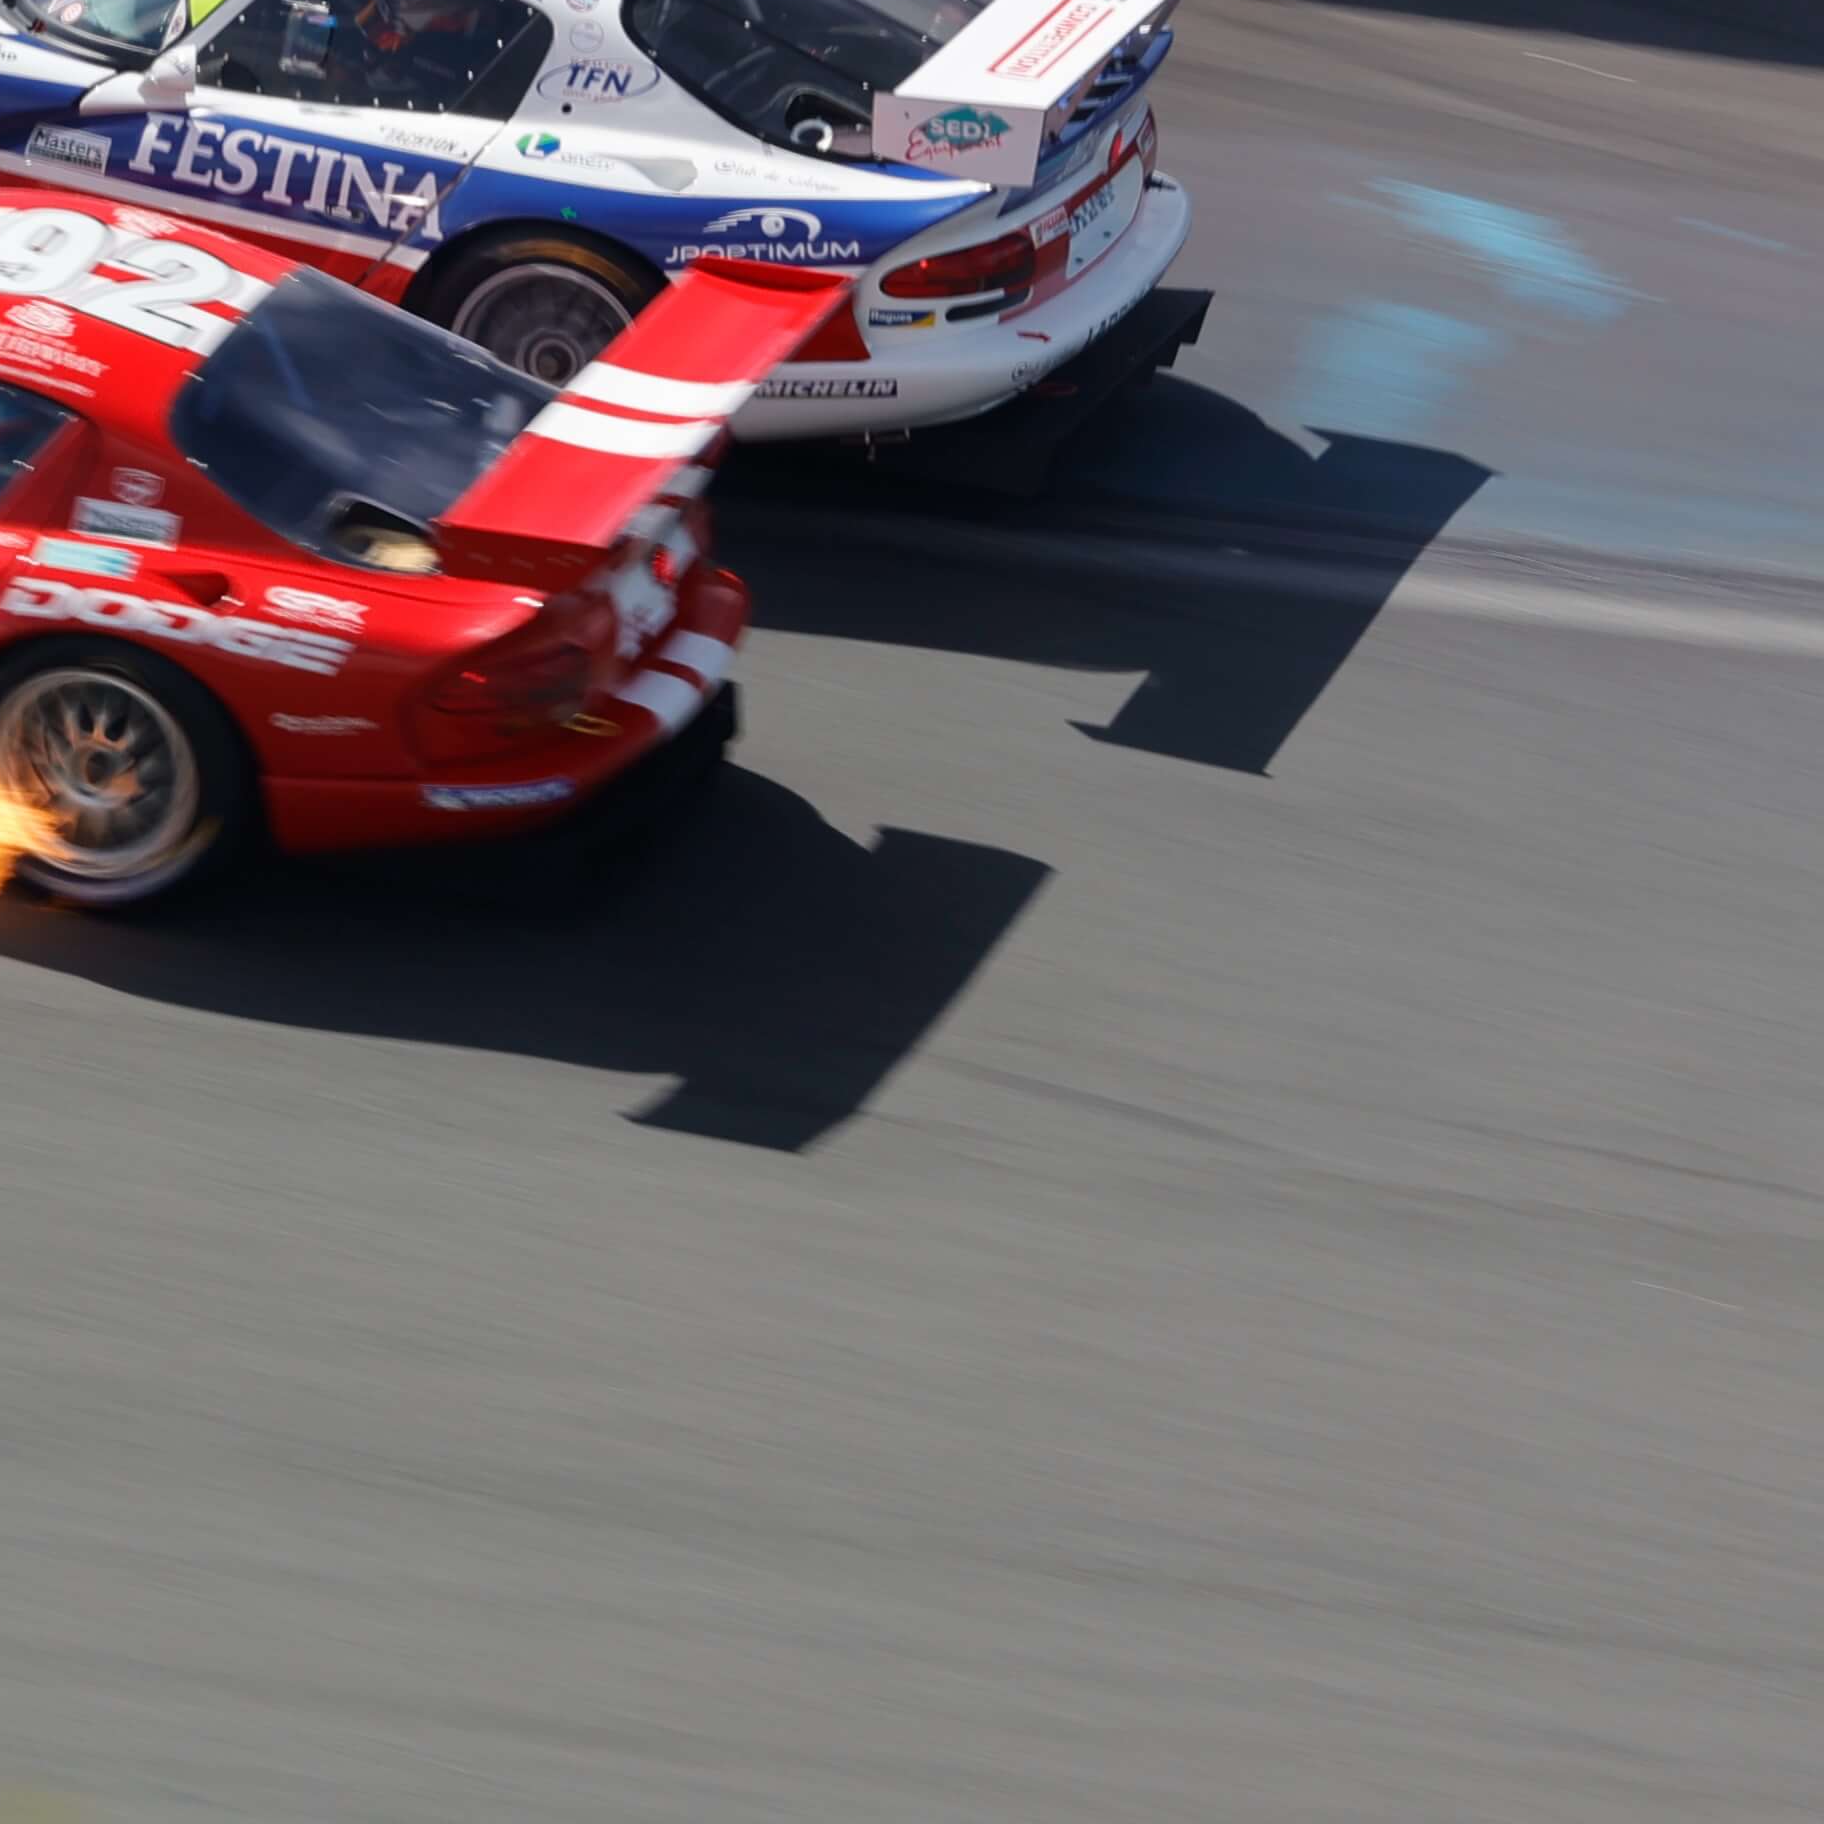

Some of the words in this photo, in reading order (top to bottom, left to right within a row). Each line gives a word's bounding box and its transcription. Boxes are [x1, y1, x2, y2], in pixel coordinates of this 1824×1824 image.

[566, 63, 633, 97] TFN
[34, 128, 104, 162] Masters
[128, 111, 445, 242] FESTINA
[755, 378, 895, 399] MICHELIN
